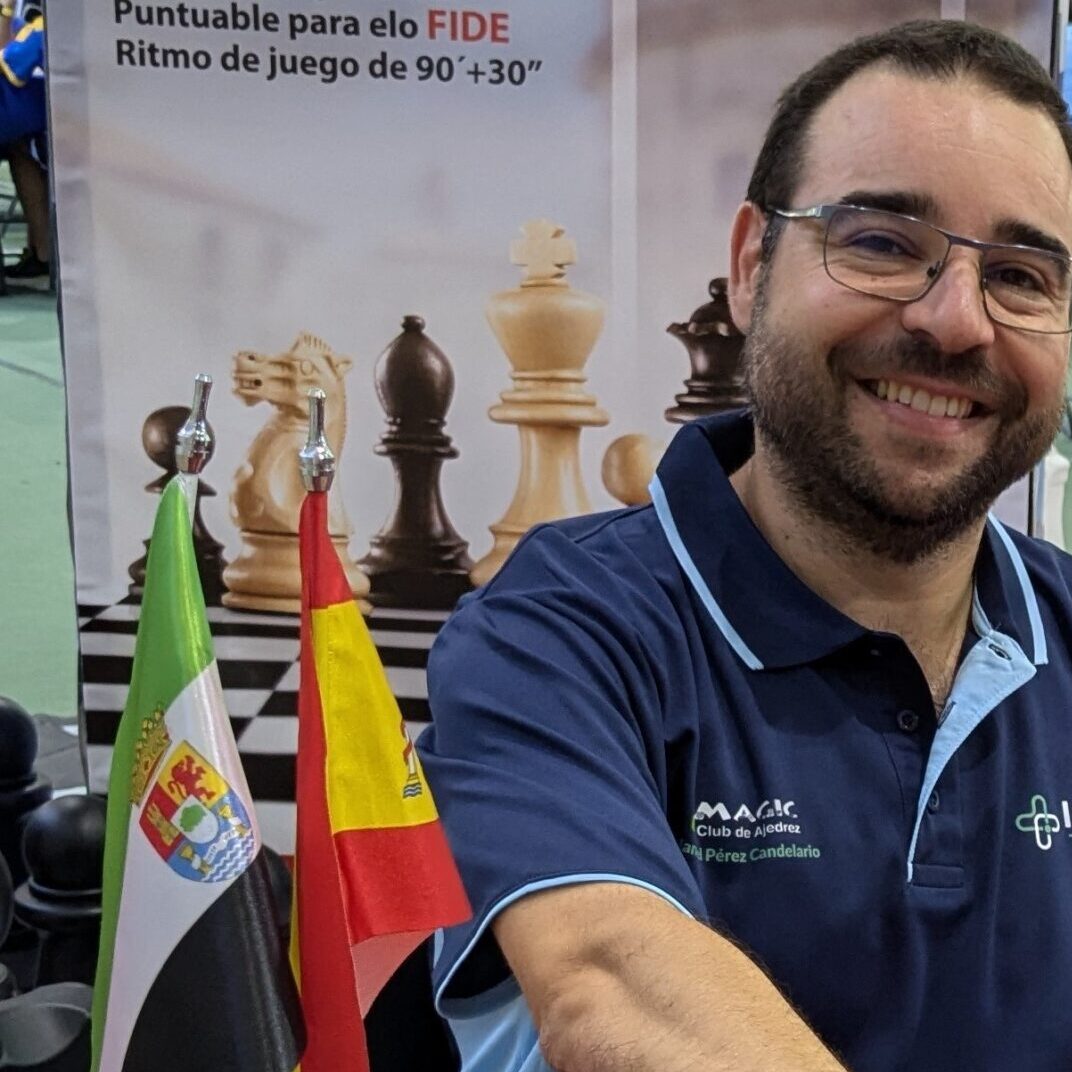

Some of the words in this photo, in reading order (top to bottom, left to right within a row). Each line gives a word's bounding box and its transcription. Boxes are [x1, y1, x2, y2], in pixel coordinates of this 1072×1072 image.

[114, 0, 280, 33] Puntuable
[288, 11, 361, 38] para
[369, 12, 418, 40] elo
[427, 9, 510, 44] FIDE
[115, 39, 212, 71] Ritmo
[221, 43, 260, 74] de
[266, 46, 360, 83] juego
[369, 51, 408, 80] de
[696, 824, 732, 837] Club
[735, 825, 751, 838] de
[754, 821, 802, 838] Ajedrez
[705, 848, 747, 863] Pérez
[750, 843, 821, 862] Candelario
